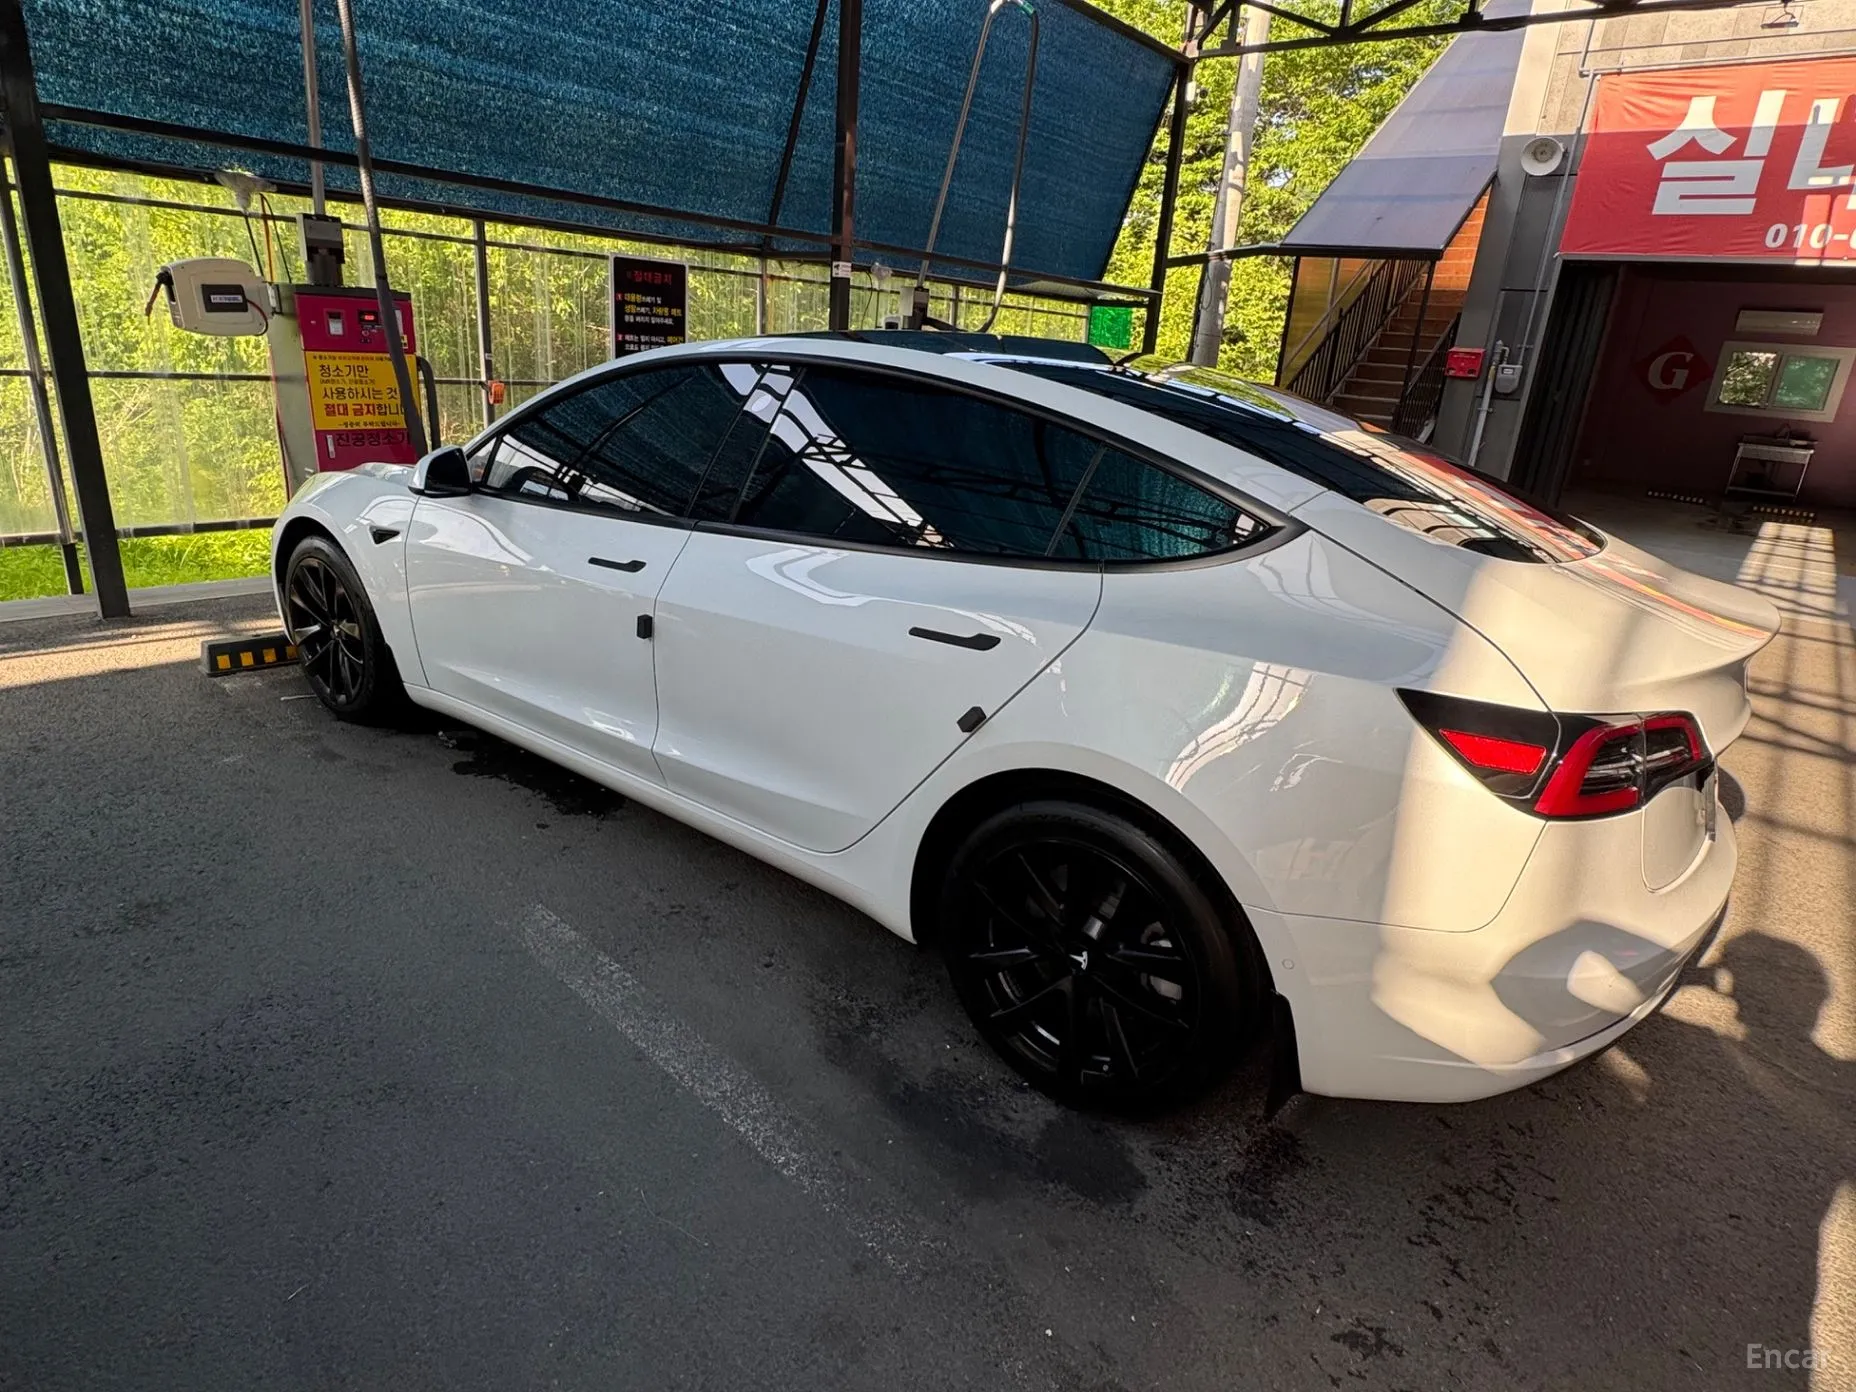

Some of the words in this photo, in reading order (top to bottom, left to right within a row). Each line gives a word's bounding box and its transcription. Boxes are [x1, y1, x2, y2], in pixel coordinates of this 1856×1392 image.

[1764, 223, 1856, 249] 010-
[319, 364, 369, 378] 청소기만
[322, 387, 383, 400] 사용하시는
[324, 403, 349, 416] 절대
[336, 432, 410, 447] 진공청소기
